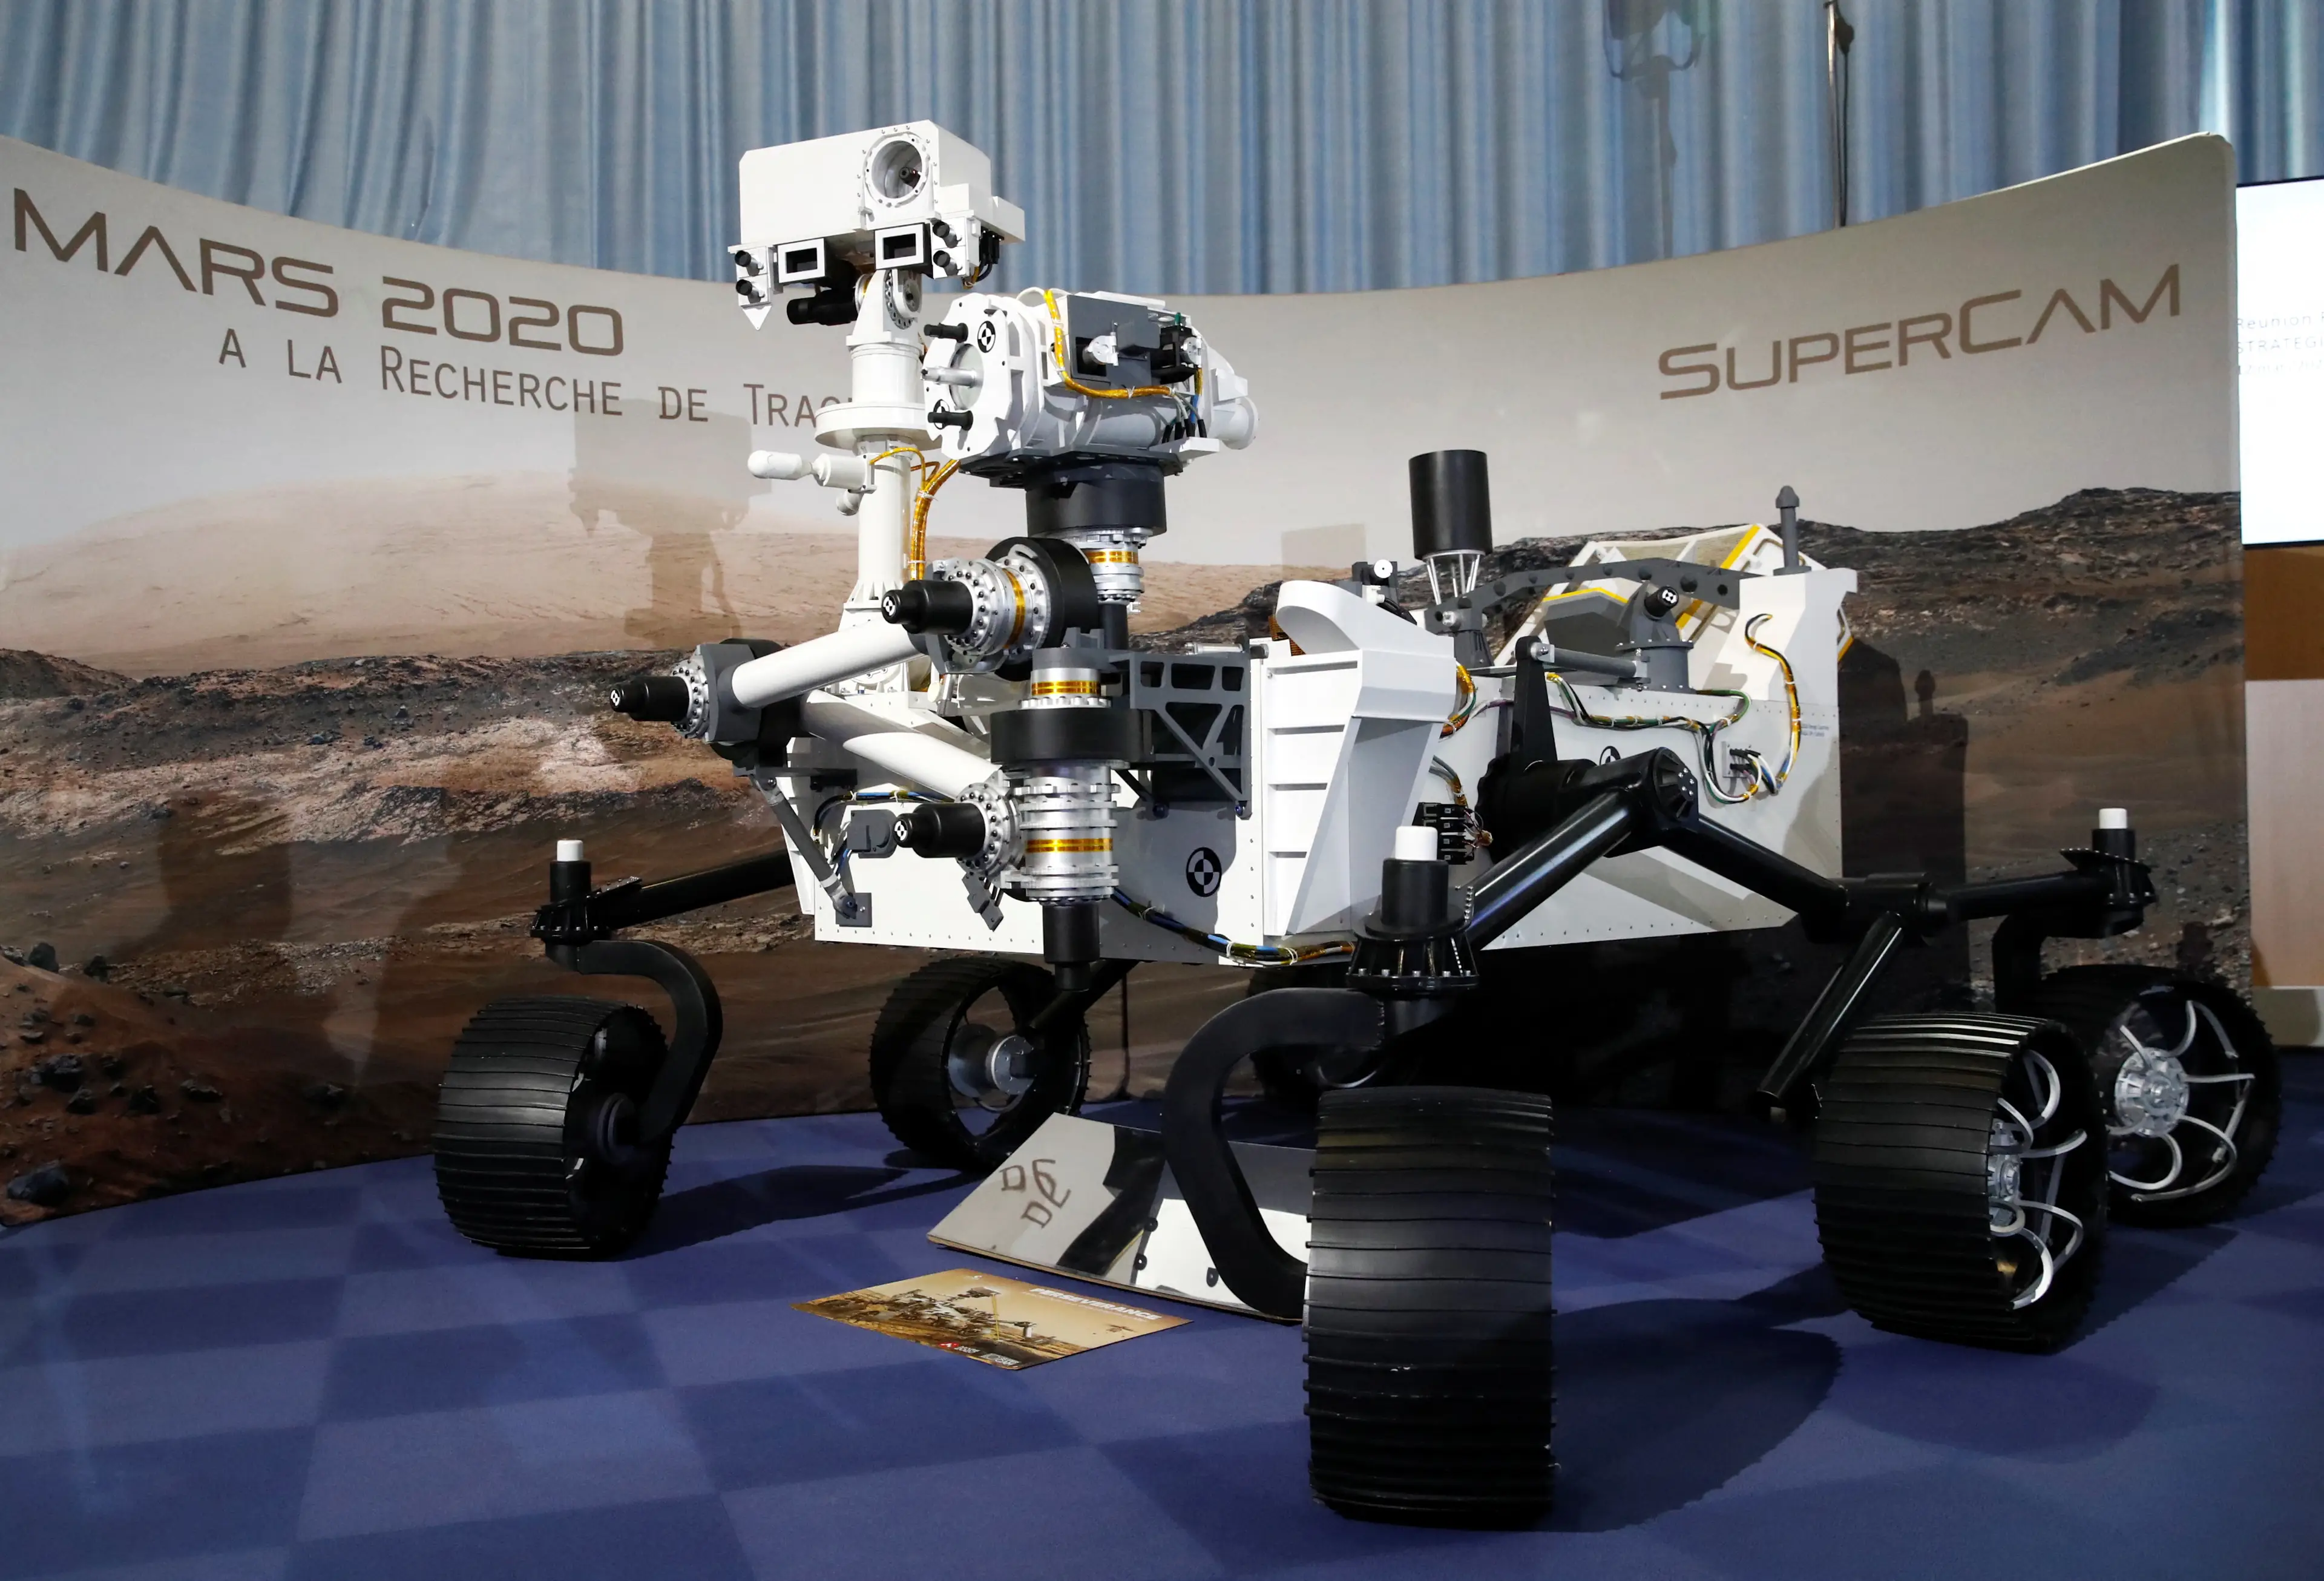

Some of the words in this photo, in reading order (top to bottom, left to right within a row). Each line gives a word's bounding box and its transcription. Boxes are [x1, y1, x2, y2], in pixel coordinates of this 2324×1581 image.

[13, 187, 339, 318] MARS
[381, 276, 624, 356] 2020
[218, 328, 246, 369] A
[287, 339, 343, 384] LA
[657, 386, 709, 422] DE
[1658, 263, 2181, 400] SUPERCAM
[1029, 1288, 1162, 1320] PERSEVERANCE
